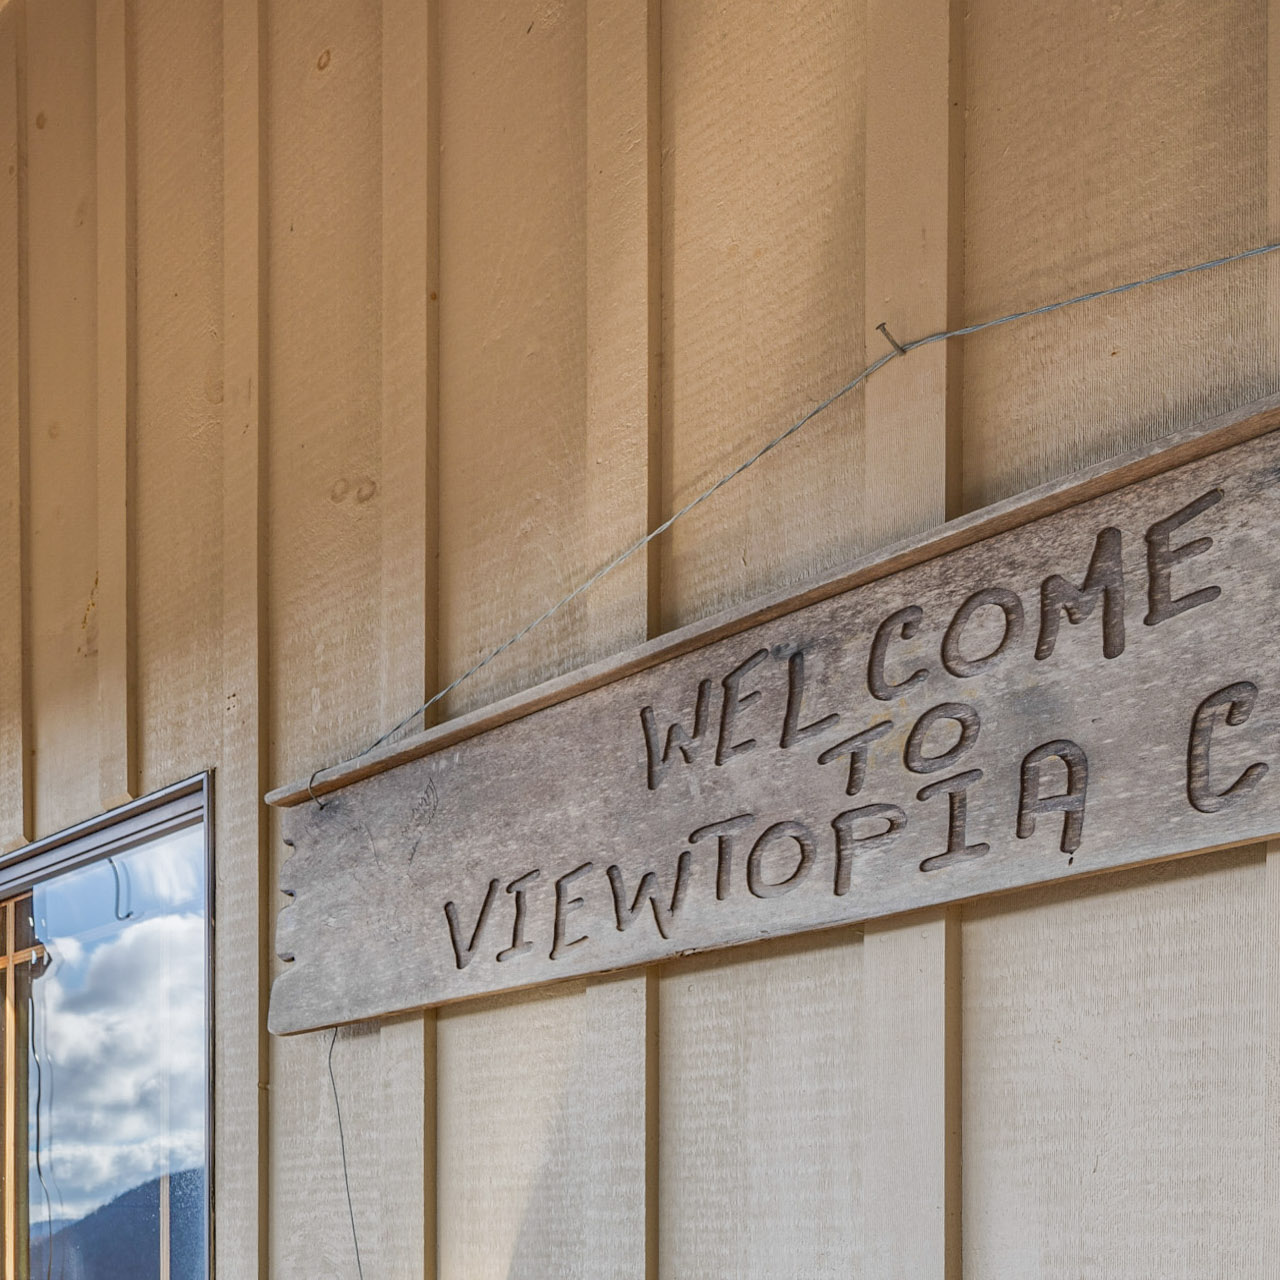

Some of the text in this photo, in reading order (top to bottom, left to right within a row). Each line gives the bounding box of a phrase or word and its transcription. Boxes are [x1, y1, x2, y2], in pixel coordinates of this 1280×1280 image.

[640, 488, 1225, 791] WELCOME
[818, 702, 981, 796] TO
[444, 739, 1090, 970] VIEWTOPIA
